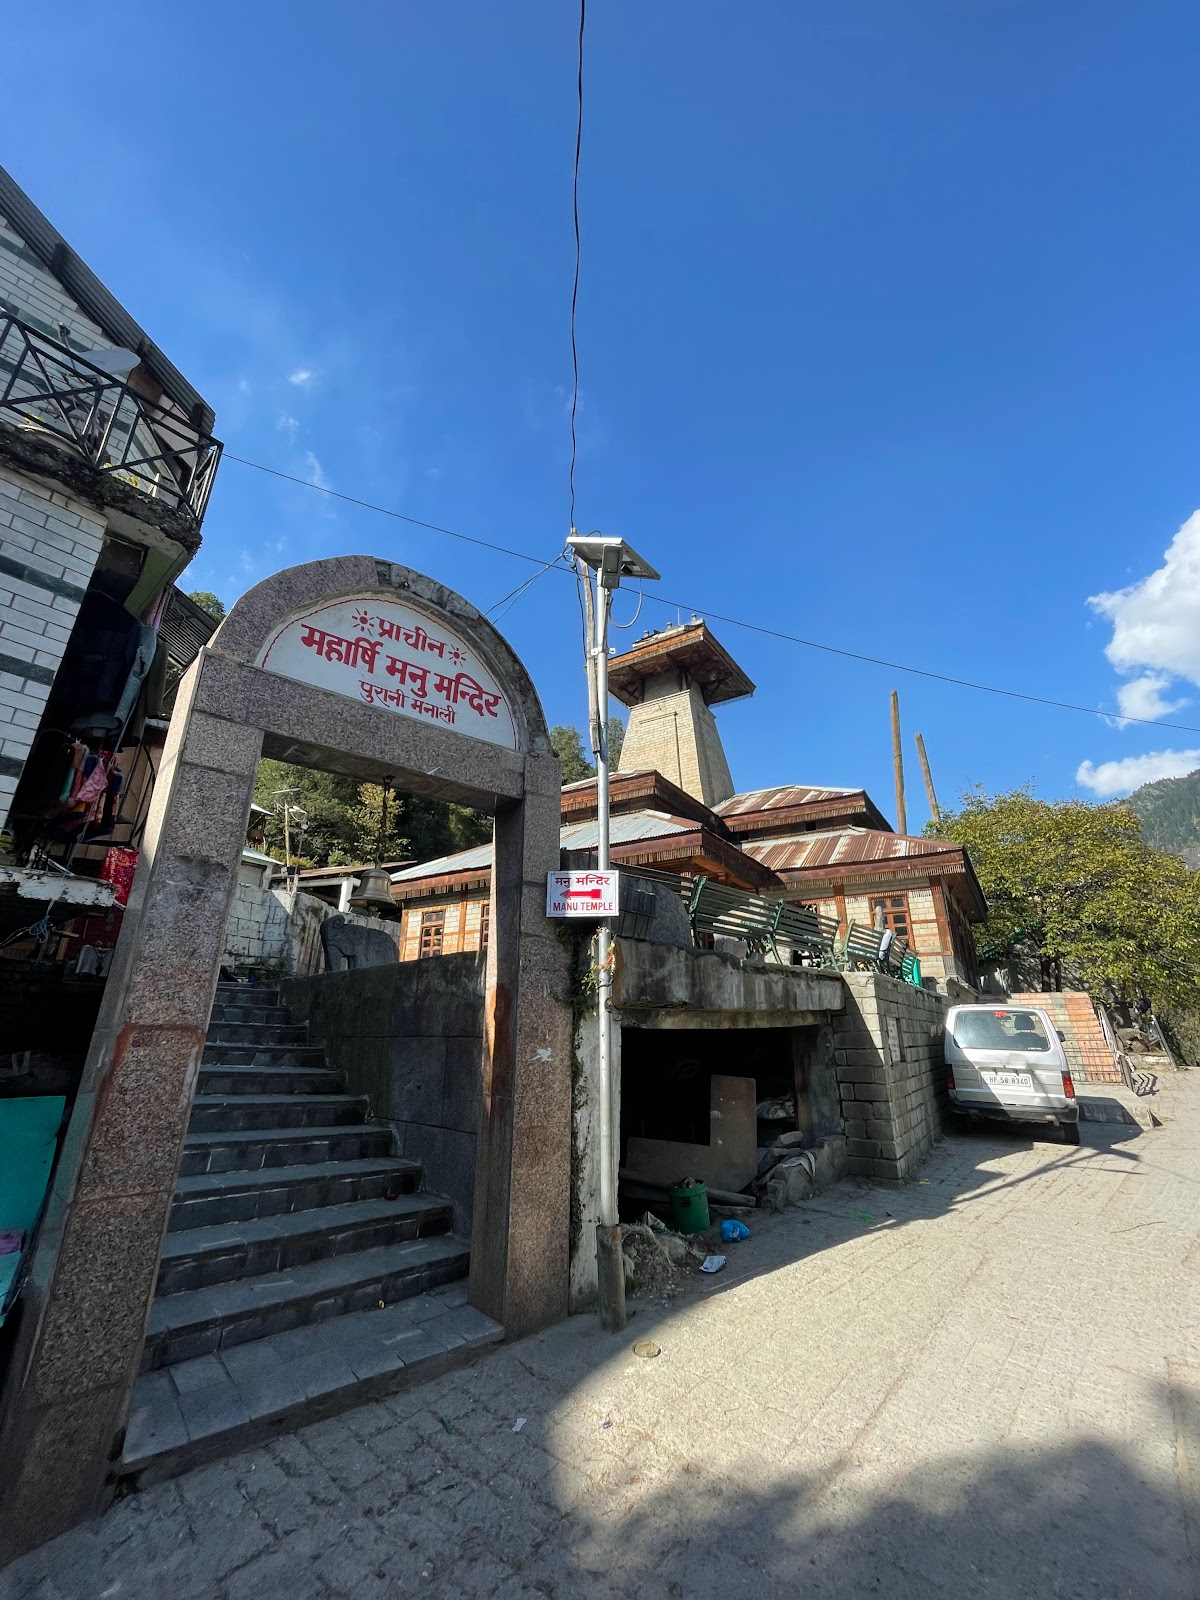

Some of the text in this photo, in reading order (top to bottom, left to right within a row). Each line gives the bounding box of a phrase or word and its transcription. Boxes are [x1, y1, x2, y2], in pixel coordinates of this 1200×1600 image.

[376, 616, 447, 659] प्राचीन
[358, 679, 458, 726] पुरानी मनाली
[385, 654, 431, 698] मनु
[434, 672, 502, 718] मन्दिर
[554, 873, 610, 888] मनु मन्दिर
[553, 902, 613, 911] MANU TEMPLE
